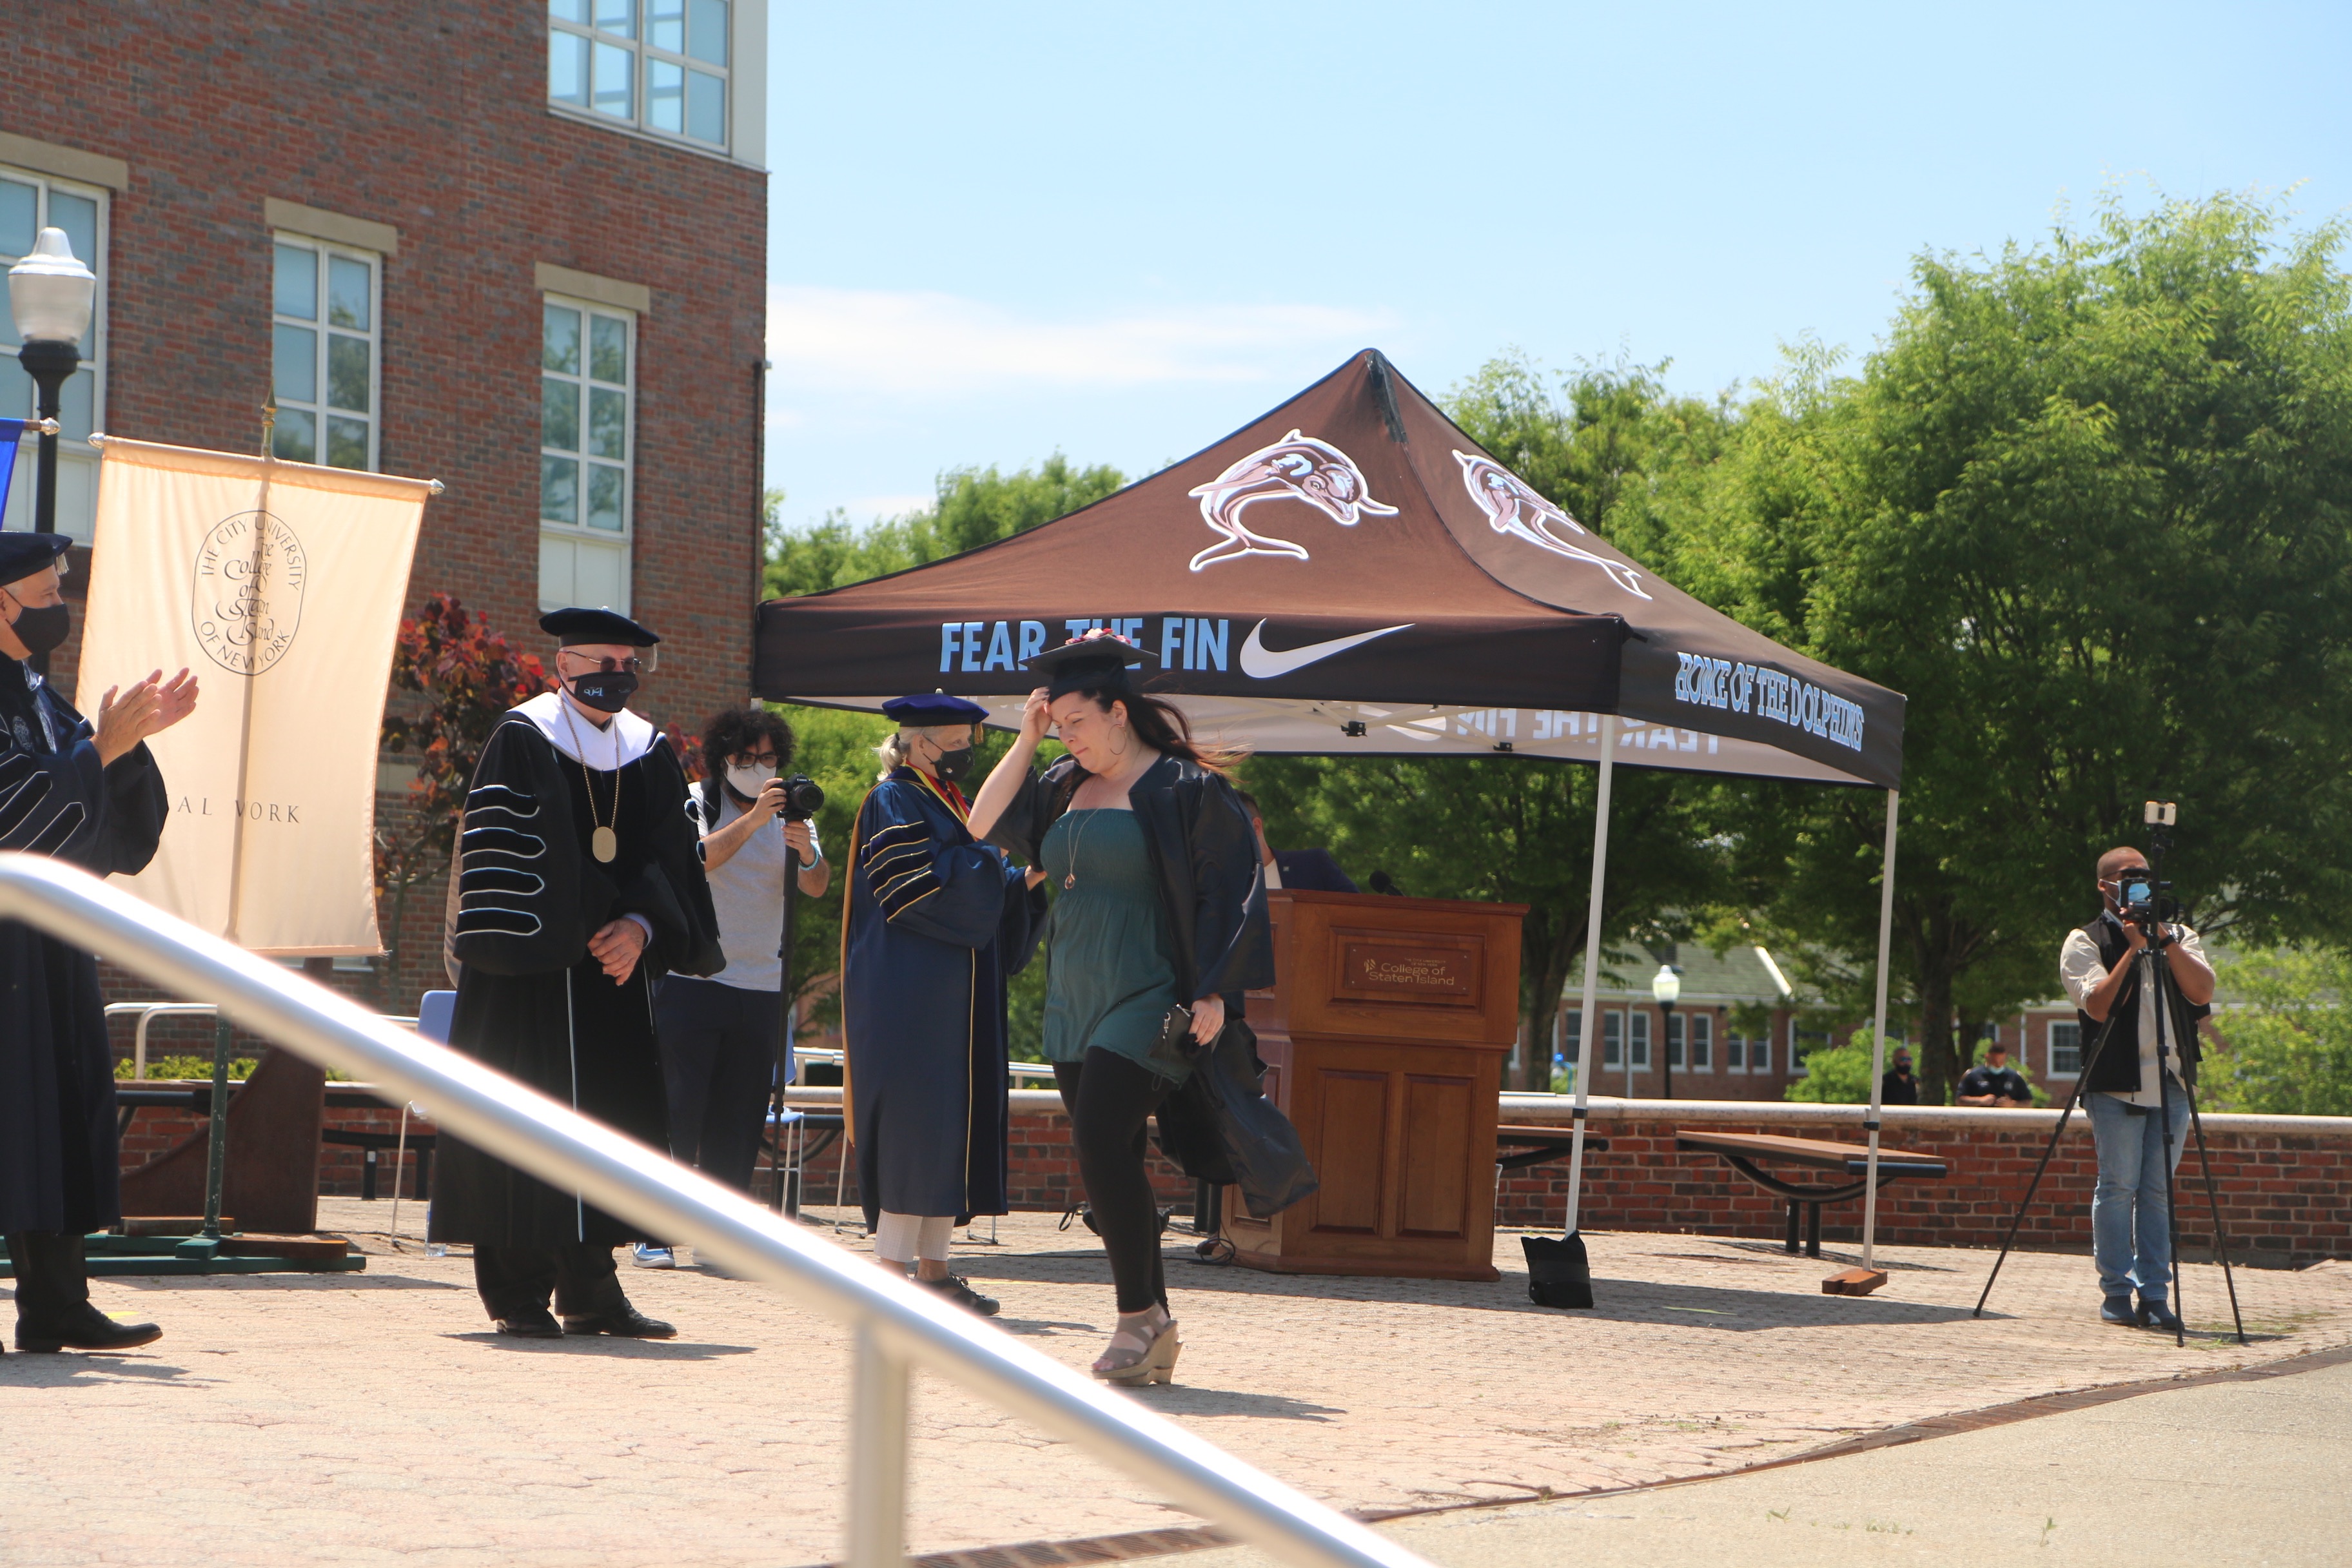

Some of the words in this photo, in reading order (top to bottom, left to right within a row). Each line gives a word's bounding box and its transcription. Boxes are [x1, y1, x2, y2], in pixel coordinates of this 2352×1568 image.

[201, 546, 220, 578] THE
[216, 518, 248, 545] CITY
[255, 516, 302, 591] UNIVERSITY
[215, 594, 270, 622] Stan
[201, 621, 221, 643] OF
[217, 645, 255, 671] NEW
[258, 629, 290, 667] YORK
[939, 620, 1046, 672] FEAR
[1065, 617, 1143, 669] TE
[1161, 616, 1229, 671] FIN
[1675, 651, 1732, 709] HOME
[1730, 662, 1757, 714] OF
[1757, 667, 1789, 723] THE
[1790, 677, 1865, 752] DOLPHINS
[166, 794, 212, 816] AL
[235, 799, 300, 824] WORK
[1369, 971, 1413, 983] Staten
[1415, 975, 1455, 986] Island
[1381, 963, 1429, 976] College
[1431, 966, 1446, 975] of
